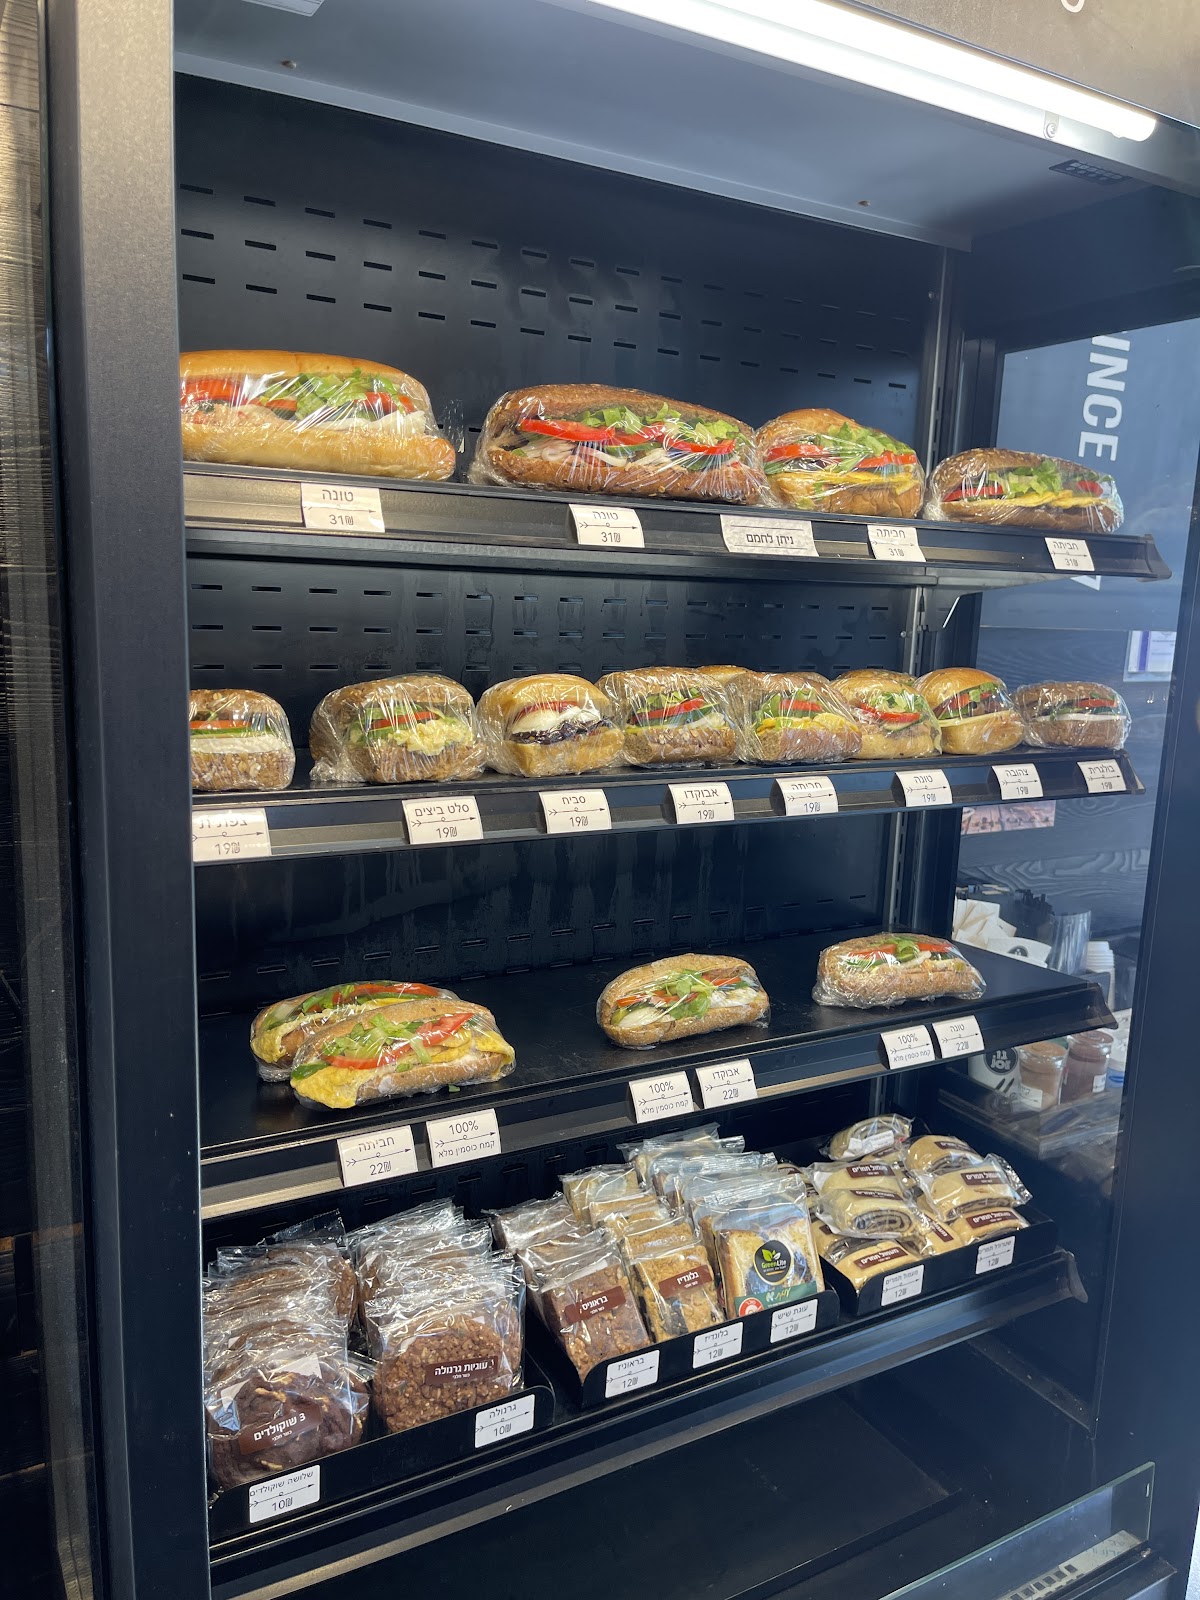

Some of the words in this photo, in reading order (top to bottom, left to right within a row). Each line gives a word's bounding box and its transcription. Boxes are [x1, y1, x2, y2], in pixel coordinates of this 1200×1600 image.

[1078, 331, 1131, 461] INCE
[322, 489, 354, 502] טונה
[592, 510, 619, 521] טונה
[746, 533, 773, 544] לחמם
[876, 528, 906, 539] חביתה
[776, 536, 794, 546] ניתן
[1053, 541, 1078, 550] חביתה
[1005, 769, 1029, 777] צהובה
[1088, 764, 1116, 774] בולגרית
[914, 775, 933, 784] טונה
[562, 795, 586, 805] סביח
[684, 788, 719, 801] אבוקדו
[414, 805, 445, 818] ביצים
[447, 803, 470, 815] סלט
[950, 1024, 965, 1033] טונה
[897, 1033, 918, 1044] 100%
[712, 1067, 740, 1080] אבוקדו
[648, 1081, 674, 1095] 100%
[641, 1105, 655, 1115] מלא
[675, 1100, 689, 1109] קמח
[448, 1120, 479, 1135] 100%
[358, 1136, 395, 1152] חביתה
[456, 1144, 478, 1156] כוסמין
[479, 1140, 495, 1150] קמח
[438, 1148, 453, 1158] מלא
[676, 1271, 699, 1285] בלונדיז
[582, 1295, 608, 1311] בראוניס
[777, 1309, 792, 1320] שיש
[793, 1305, 808, 1315] עוגת
[704, 1330, 729, 1342] בלונדיז
[435, 1363, 462, 1376] גרנולה
[464, 1360, 488, 1372] עוגיות
[618, 1357, 644, 1371] בראוניז
[299, 1412, 306, 1422] 3
[489, 1404, 517, 1419] גרנולה
[253, 1418, 297, 1441] שוקולדים
[287, 1471, 314, 1485] שלושה
[249, 1480, 285, 1497] שוקולדים
